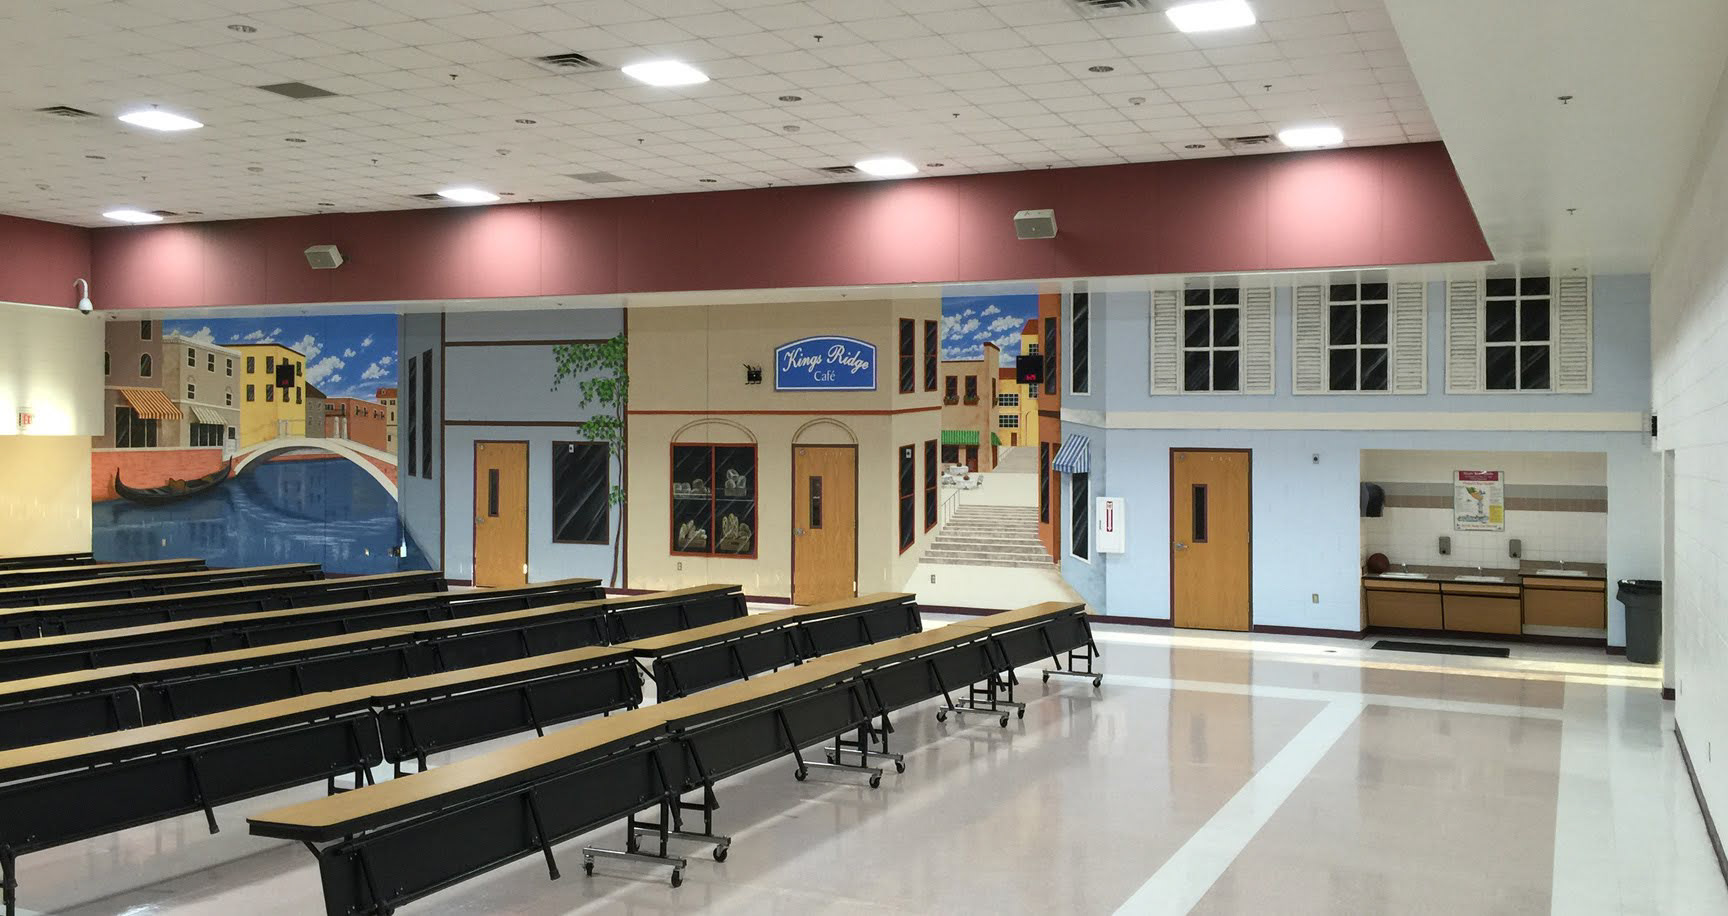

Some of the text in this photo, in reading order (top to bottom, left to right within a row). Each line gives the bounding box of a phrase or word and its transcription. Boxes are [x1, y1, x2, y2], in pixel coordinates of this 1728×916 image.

[783, 344, 869, 374] Kings Ridge
[814, 370, 836, 382] Café
